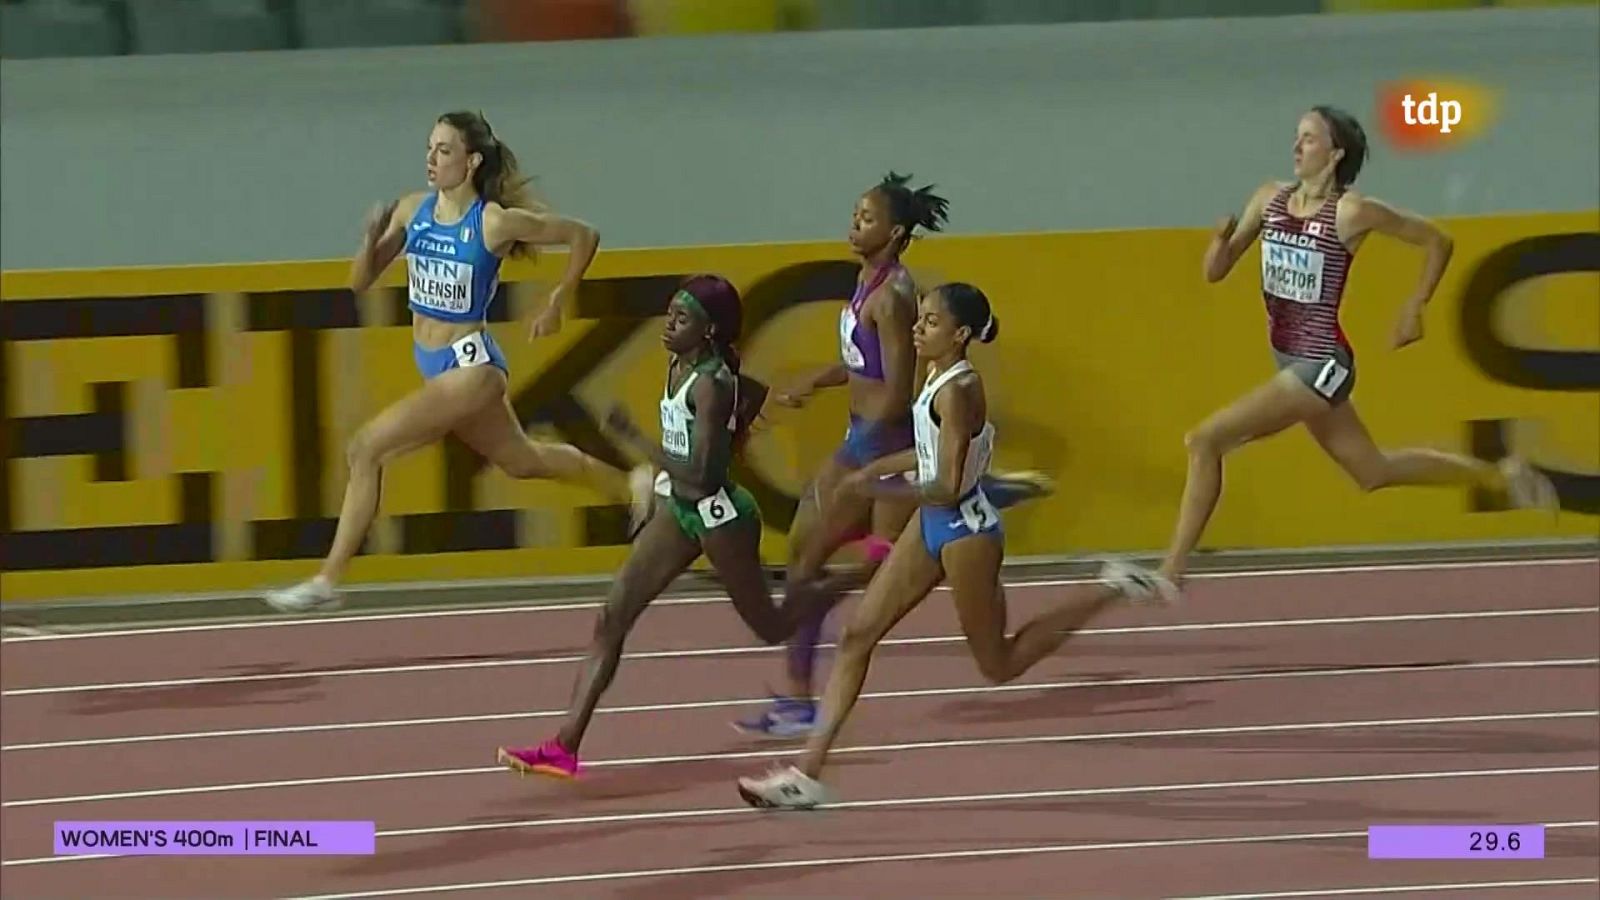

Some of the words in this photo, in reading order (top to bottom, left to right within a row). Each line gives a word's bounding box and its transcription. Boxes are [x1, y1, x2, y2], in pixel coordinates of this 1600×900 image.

[415, 239, 456, 255] ITALIA
[1263, 229, 1317, 249] CANADA
[1270, 247, 1309, 268] NTN
[415, 258, 458, 279] NTN
[410, 273, 466, 300] VALENSIN
[462, 342, 477, 362] 9
[709, 500, 726, 519] 6
[971, 500, 987, 528] 5
